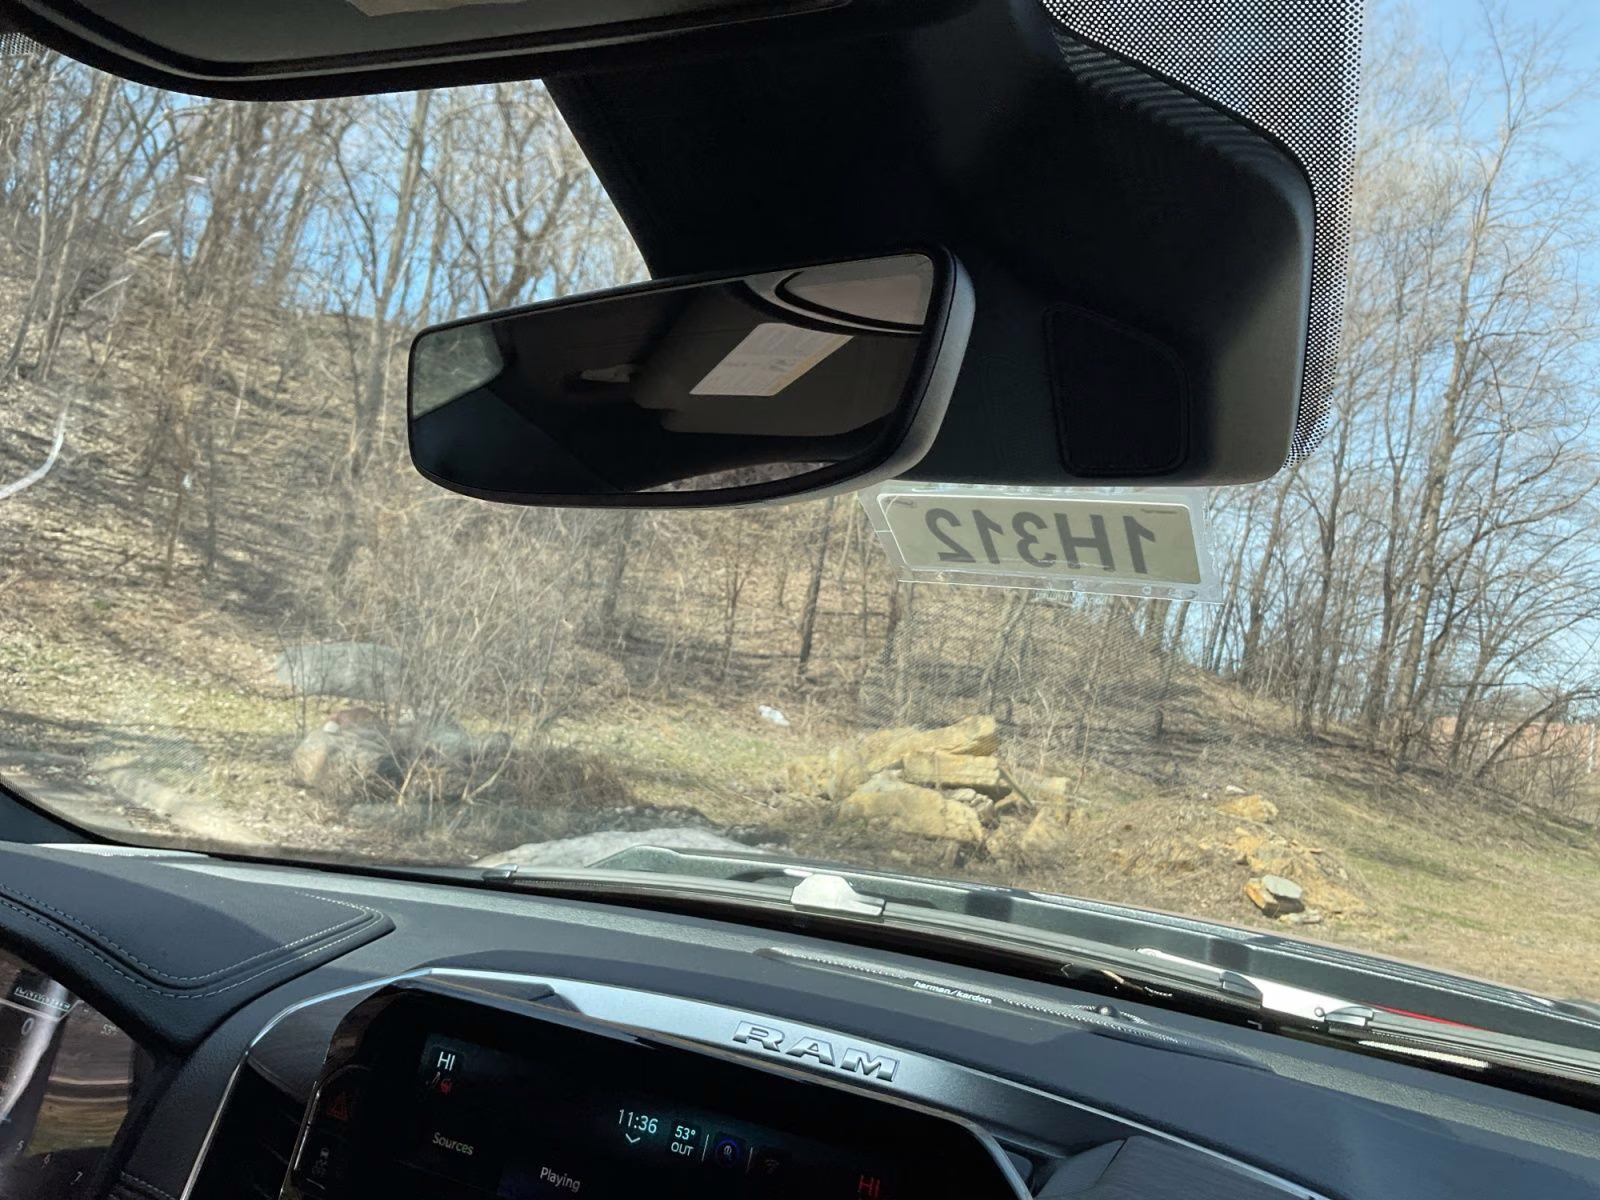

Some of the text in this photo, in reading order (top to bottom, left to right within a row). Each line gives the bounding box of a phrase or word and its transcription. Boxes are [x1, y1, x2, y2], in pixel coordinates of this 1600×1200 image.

[913, 980, 992, 1005] harman/kardon
[436, 1051, 456, 1071] HI
[733, 1020, 900, 1082] RAM
[617, 1108, 659, 1134] 11:36
[431, 1132, 475, 1156] Sources
[674, 1125, 697, 1142] 53°
[670, 1142, 694, 1157] OUT
[540, 1166, 581, 1193] Playing
[857, 1174, 882, 1198] HI
